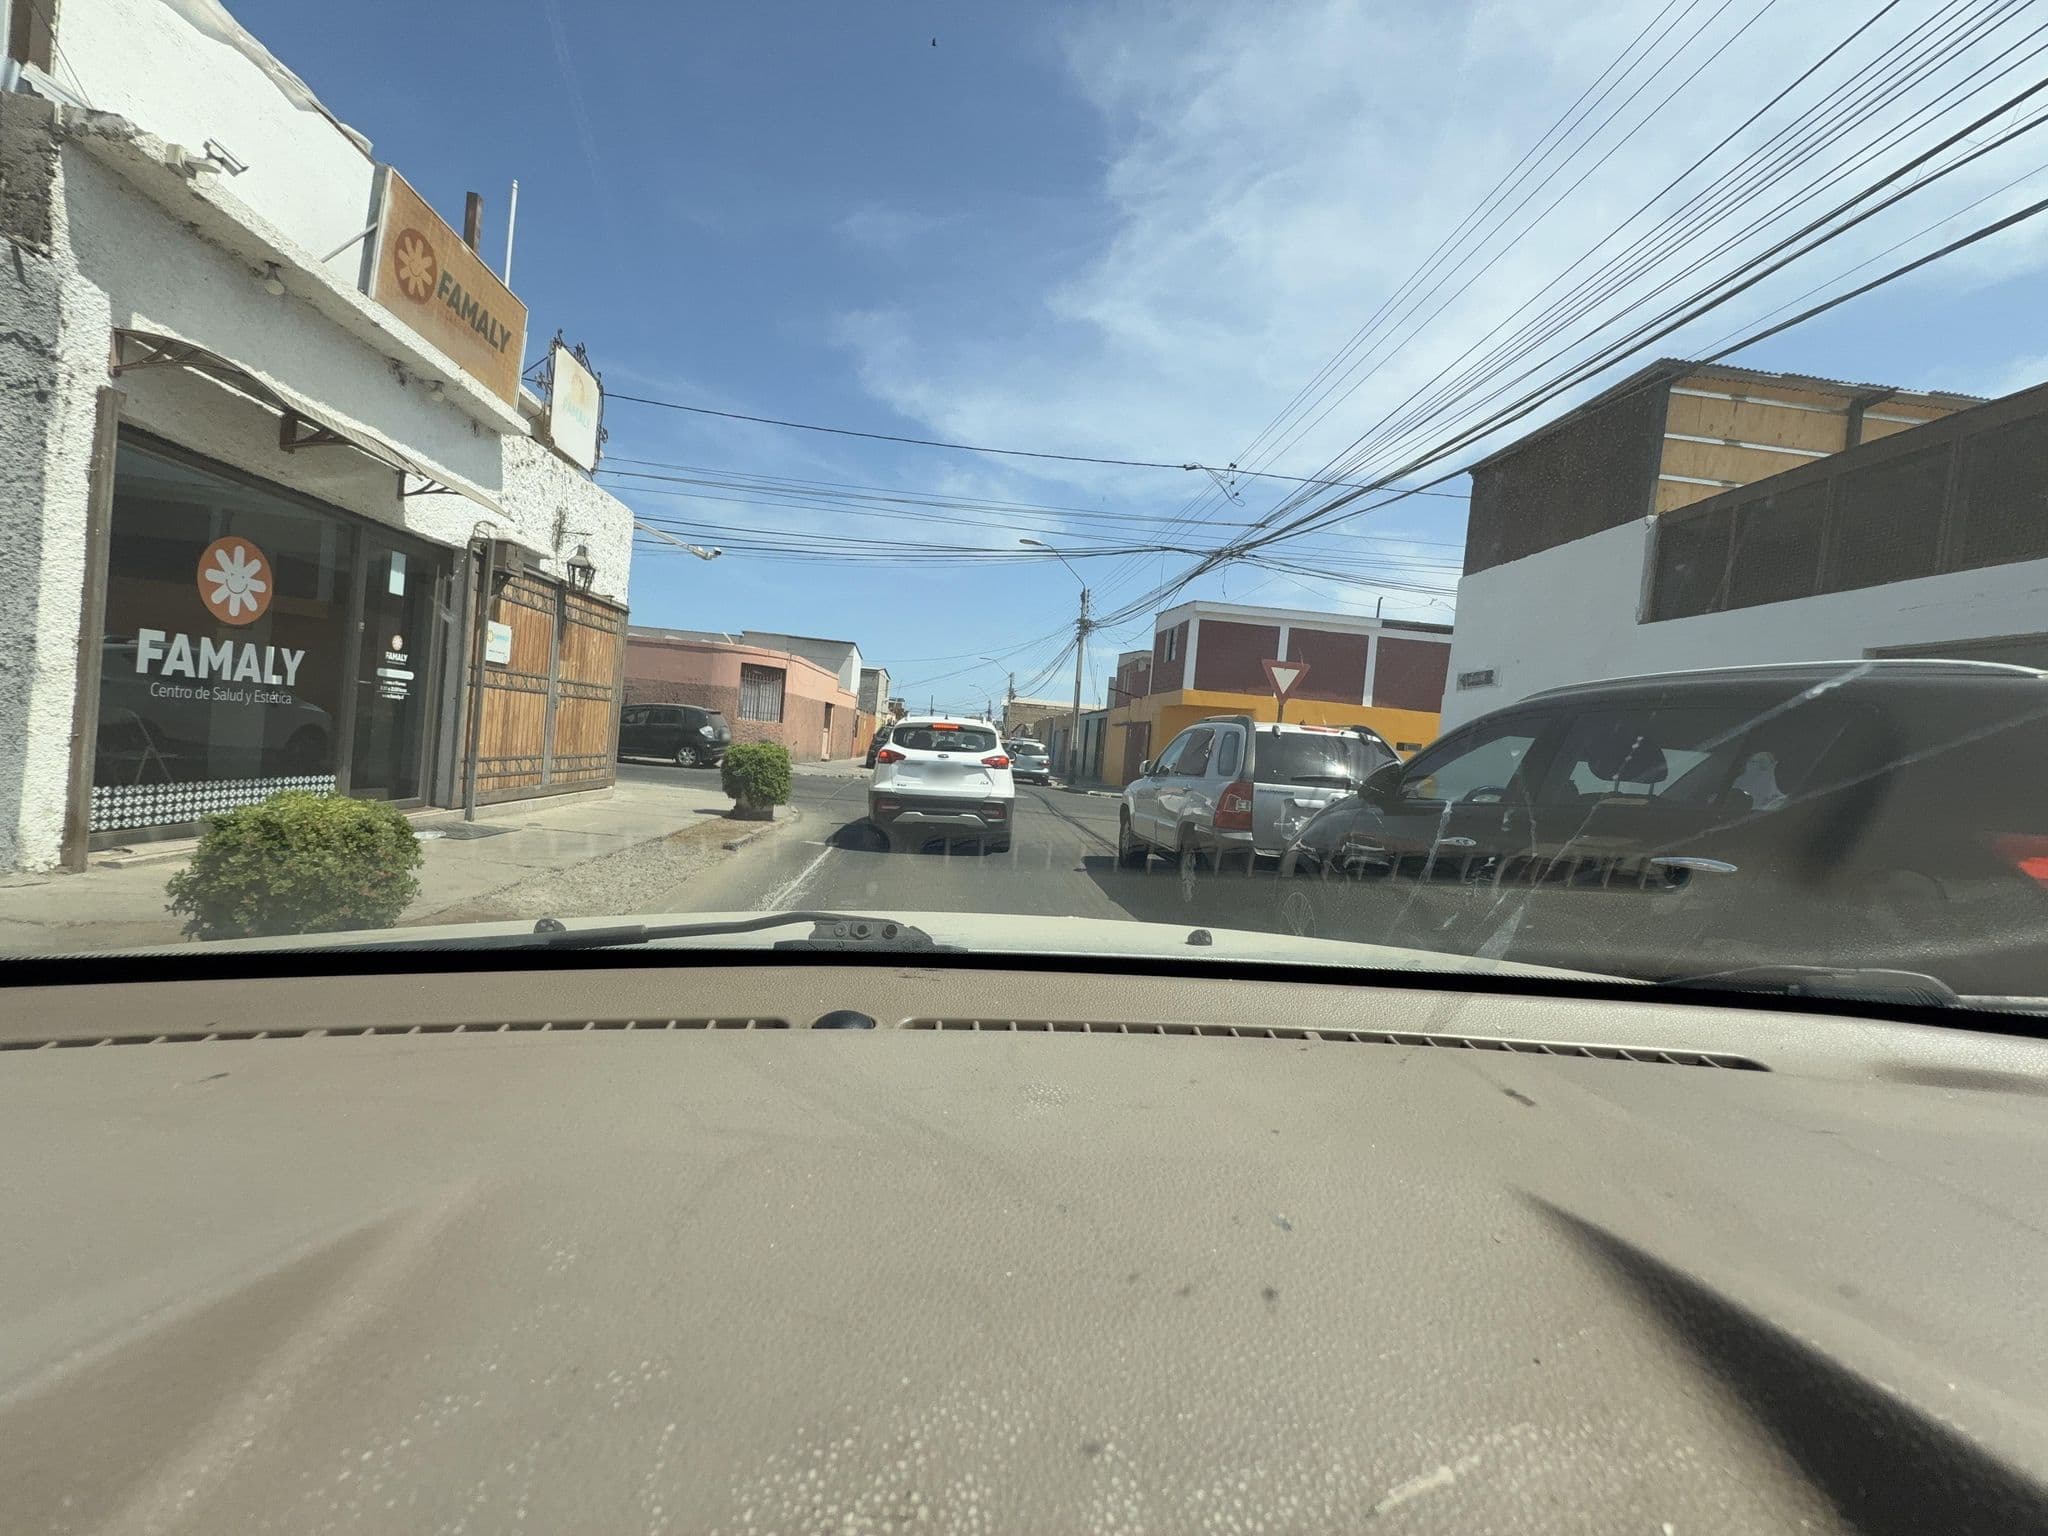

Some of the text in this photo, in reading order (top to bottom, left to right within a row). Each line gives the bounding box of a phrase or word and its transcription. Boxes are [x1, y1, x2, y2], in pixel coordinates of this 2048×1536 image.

[437, 270, 511, 354] FAMALY
[136, 628, 306, 686] FAMALY
[385, 651, 408, 662] FAMALY
[150, 682, 292, 706] Centro de Salud y Estética
